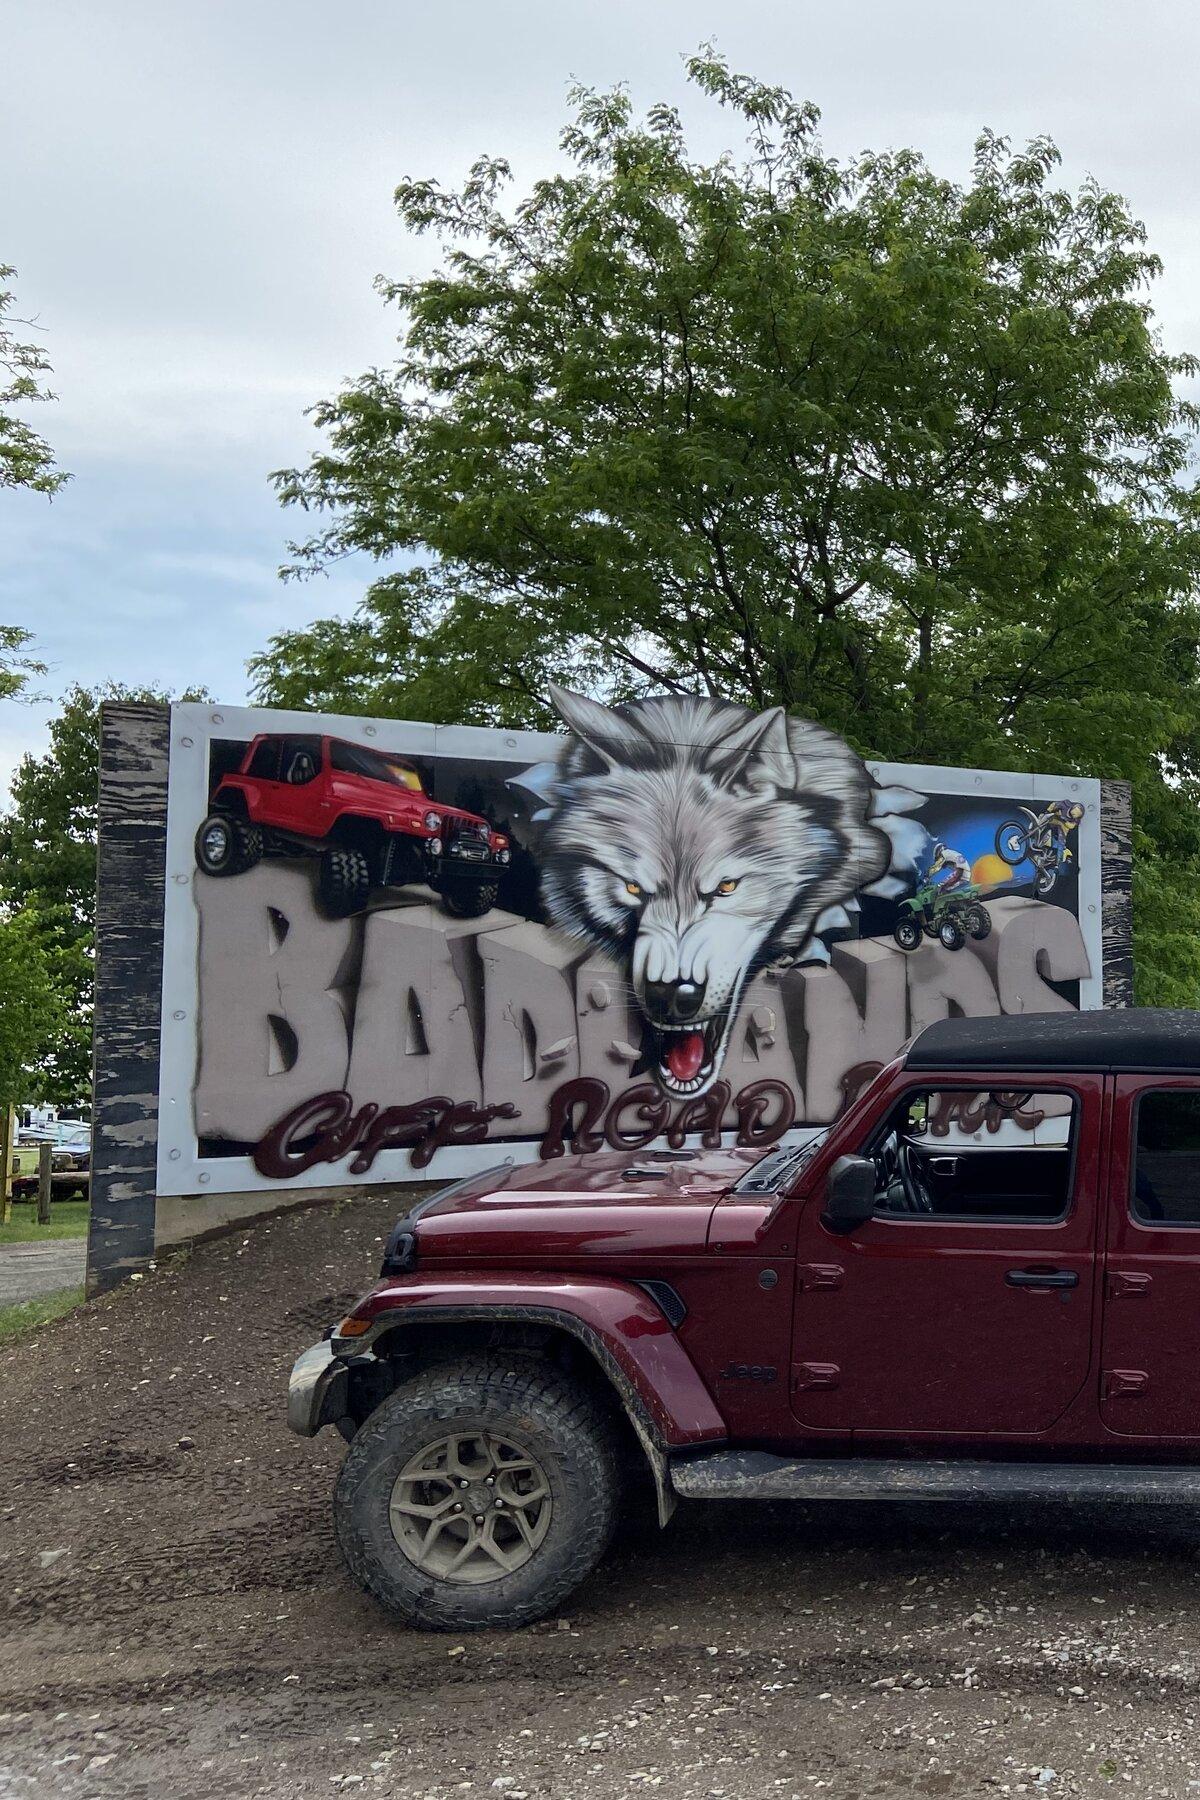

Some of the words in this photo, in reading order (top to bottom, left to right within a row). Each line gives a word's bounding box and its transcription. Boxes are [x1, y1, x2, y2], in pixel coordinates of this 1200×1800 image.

[253, 1090, 522, 1179] OFF
[539, 1076, 796, 1160] ROAD
[719, 1360, 777, 1384] Jeep
